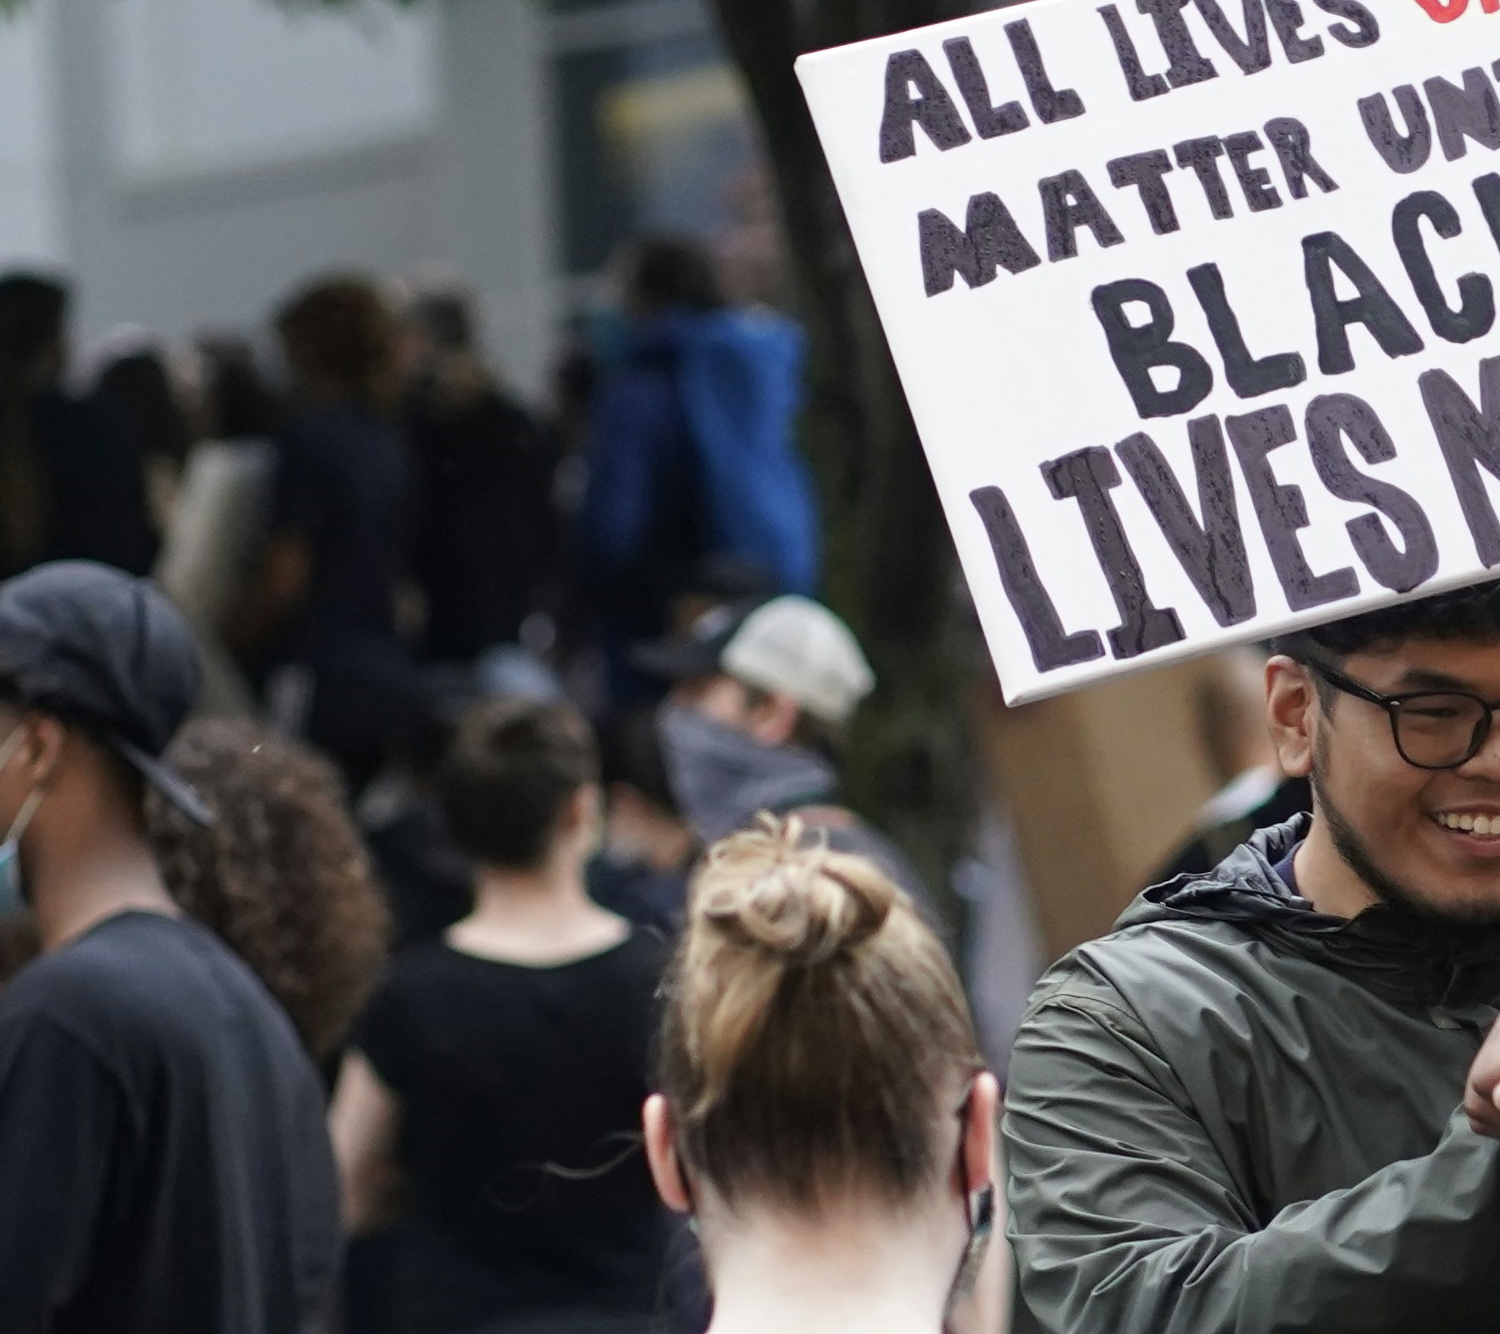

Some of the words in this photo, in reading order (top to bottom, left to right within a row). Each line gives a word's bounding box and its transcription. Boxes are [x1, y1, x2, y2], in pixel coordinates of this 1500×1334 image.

[879, 18, 1086, 164] ALL
[917, 117, 1340, 298] MATTER
[968, 393, 1440, 674] LIVES
